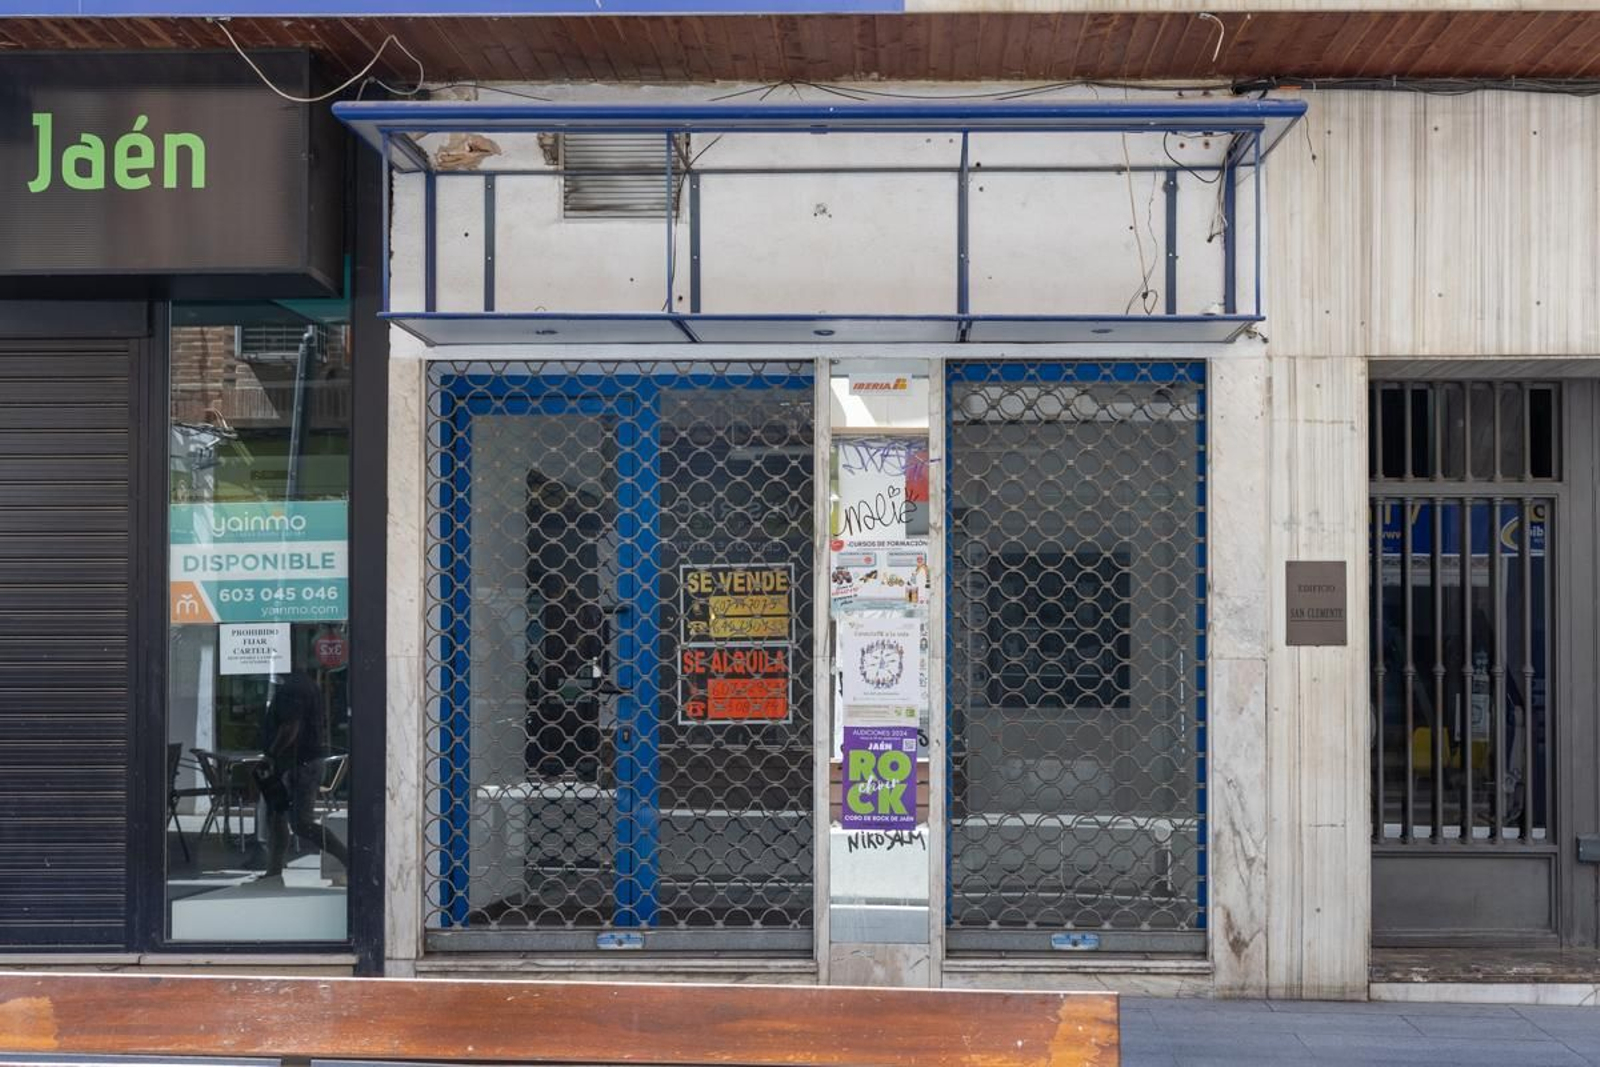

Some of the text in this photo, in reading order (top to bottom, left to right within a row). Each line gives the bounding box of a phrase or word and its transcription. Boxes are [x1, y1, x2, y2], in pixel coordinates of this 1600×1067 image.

[28, 112, 206, 193] Jaén
[853, 382, 891, 390] IBERIA
[212, 511, 306, 537] yainmo
[183, 552, 336, 573] DISPONIBLE
[687, 571, 789, 593] SE VENDE
[219, 586, 338, 602] 603 045 046
[261, 605, 339, 616] yainmo.com
[1290, 608, 1344, 619] SAN CLEMENTE
[231, 628, 279, 638] PROHIBIDO
[243, 638, 267, 646] FIJAR
[233, 647, 278, 656] CARTELES
[683, 651, 787, 674] SE ALQUILA
[853, 729, 908, 737] AUDICIONES 2024
[868, 741, 893, 751] JAÉN
[899, 814, 914, 822] JAÉN
